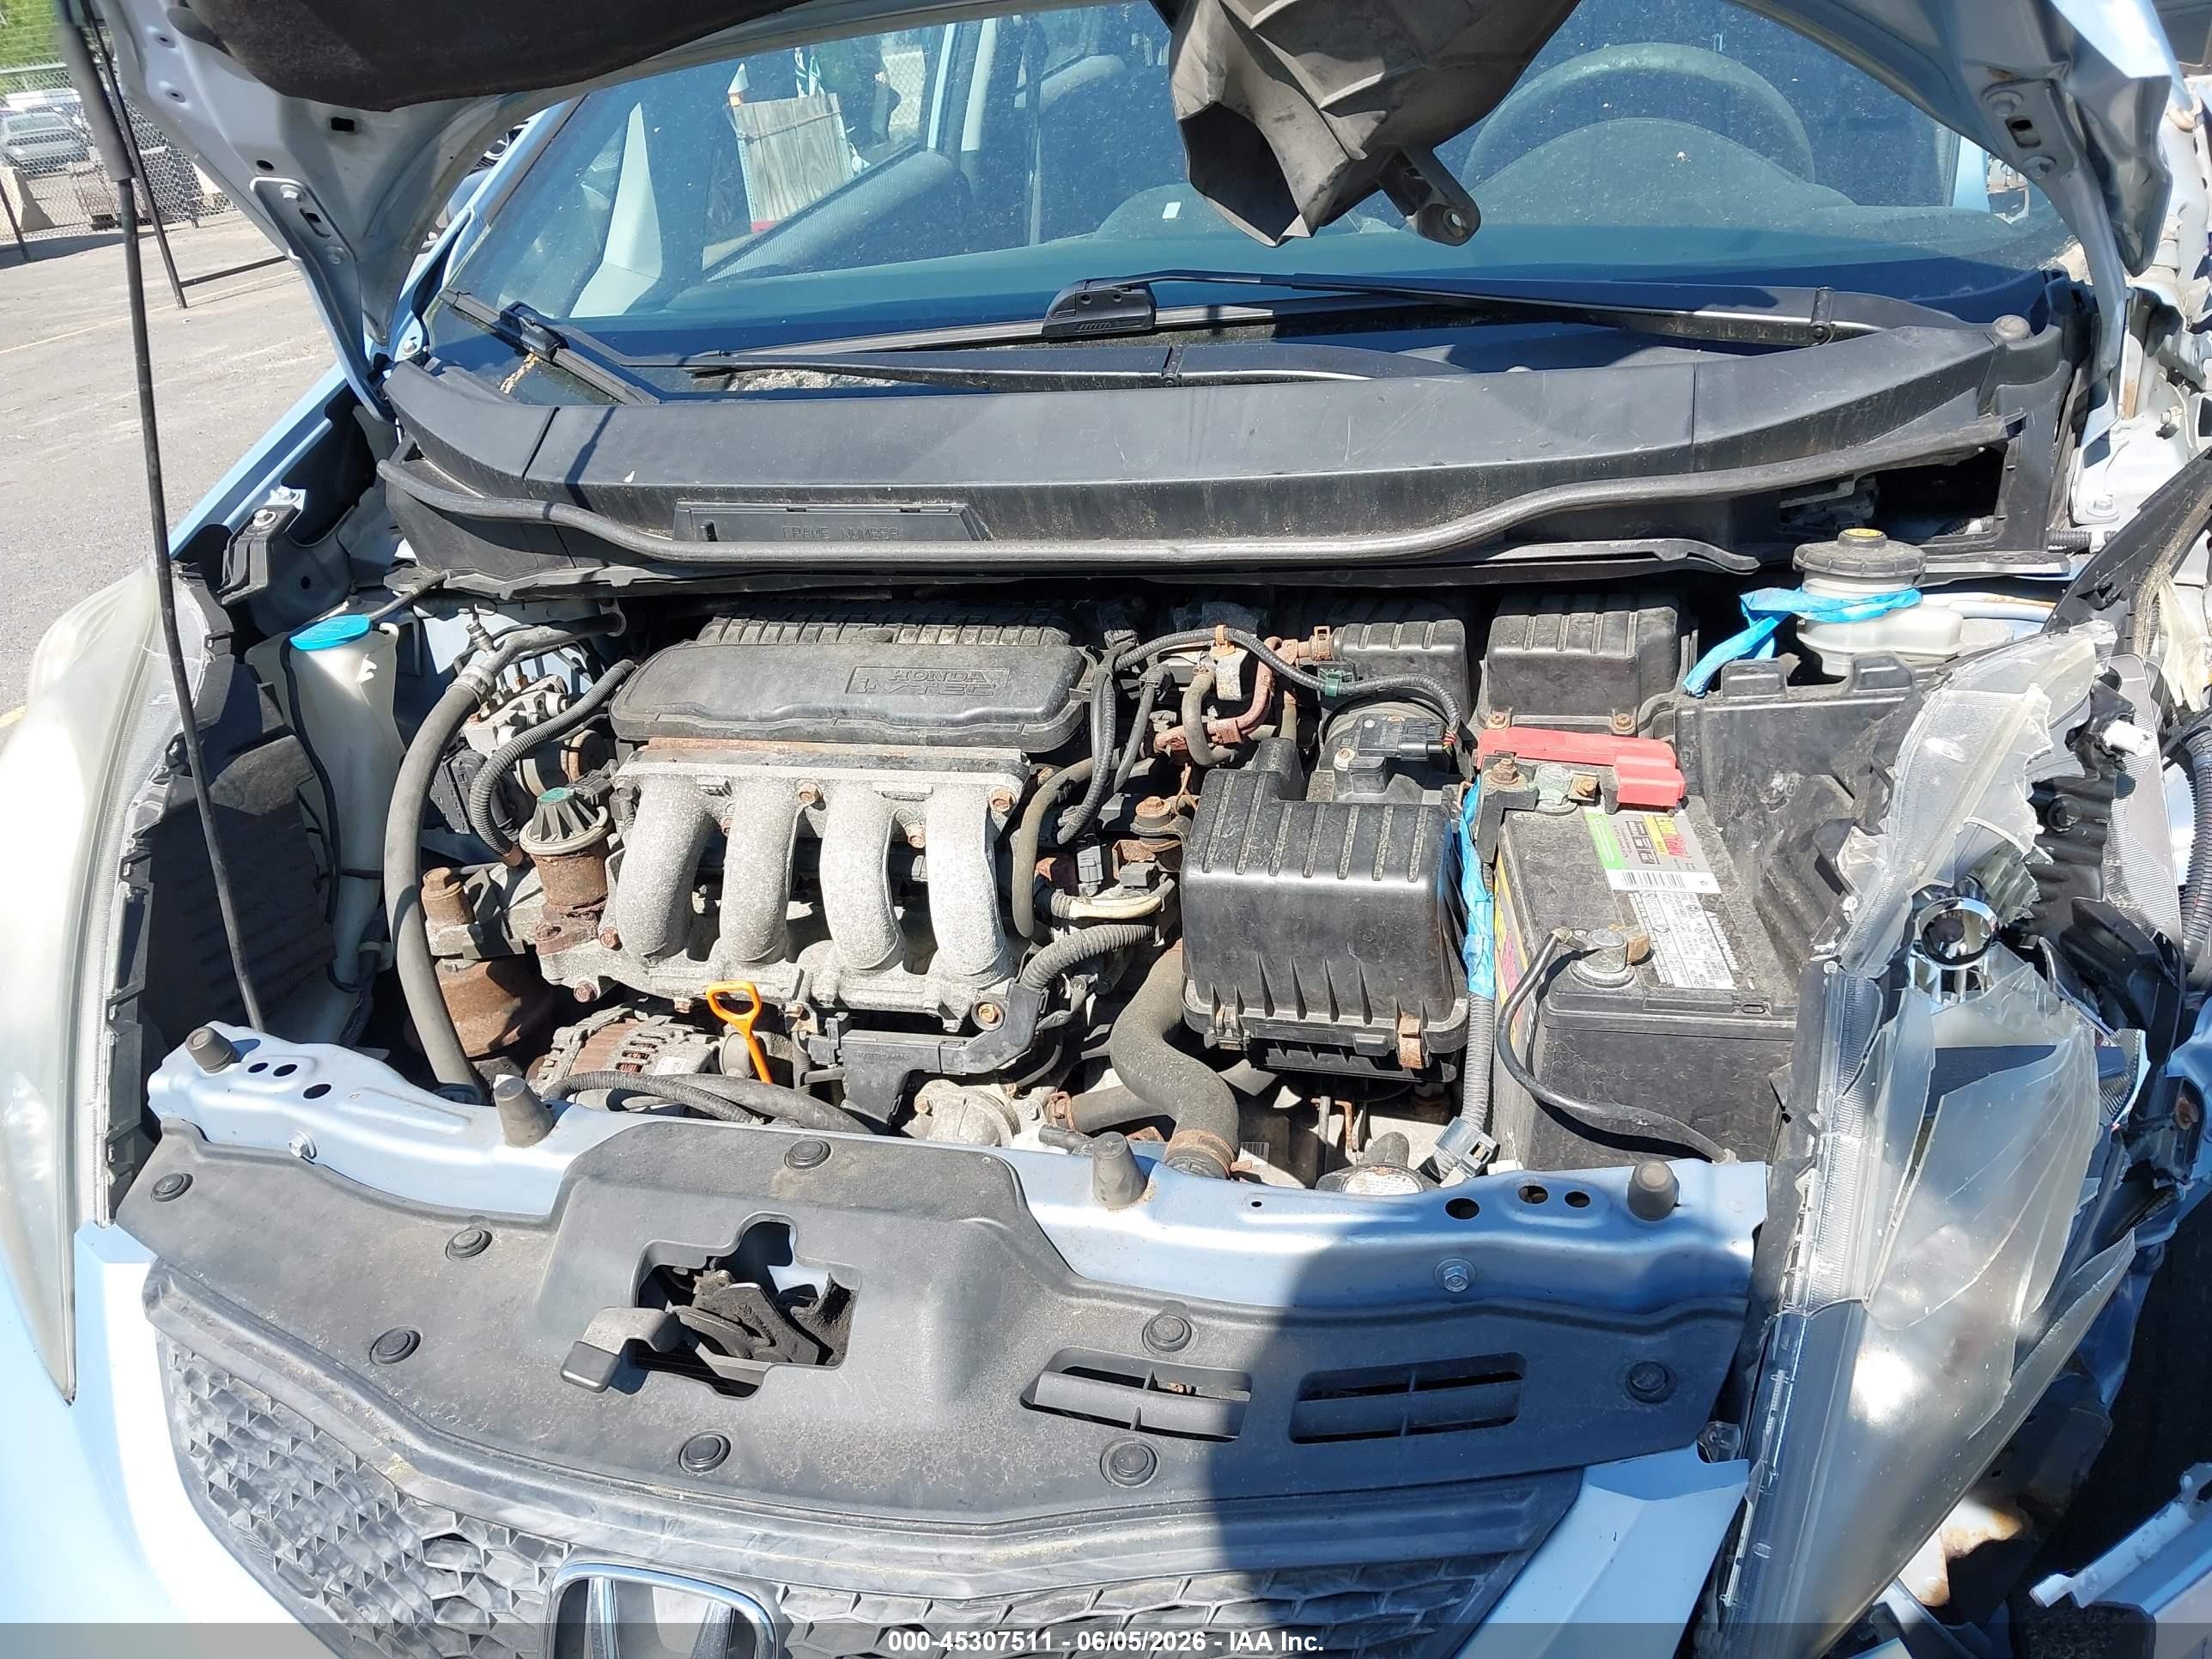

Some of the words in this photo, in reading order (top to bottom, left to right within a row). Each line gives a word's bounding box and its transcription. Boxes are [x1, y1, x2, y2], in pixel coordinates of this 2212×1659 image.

[782, 526, 831, 541] FRAME
[840, 526, 902, 541] NUMBER
[889, 670, 988, 683] HONDA
